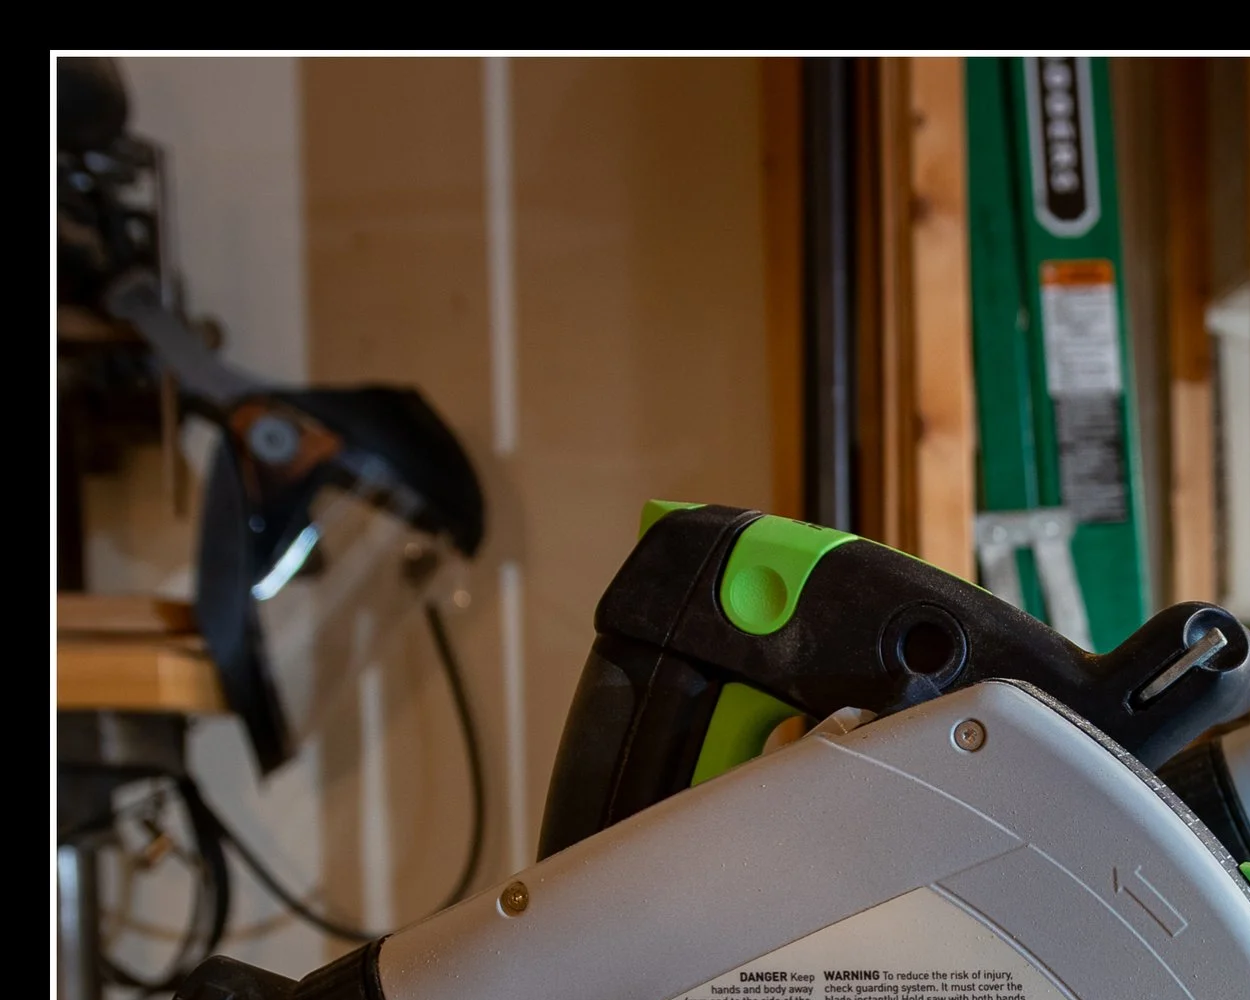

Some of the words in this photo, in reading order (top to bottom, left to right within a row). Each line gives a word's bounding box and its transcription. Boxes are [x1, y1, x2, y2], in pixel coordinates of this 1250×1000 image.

[740, 970, 788, 982] DANGER
[791, 971, 815, 984] Keep
[823, 970, 880, 981] WARNING
[883, 970, 894, 980] To
[897, 970, 930, 981] reduce
[932, 970, 948, 980] the
[951, 969, 969, 980] risk
[972, 969, 981, 979] of
[984, 969, 1013, 983] injury,
[711, 984, 741, 995] hands
[743, 984, 761, 994] and
[763, 983, 787, 997] body
[789, 985, 814, 997] away
[825, 983, 854, 993] check
[855, 982, 899, 996] guarding
[901, 982, 939, 996] system.
[941, 981, 949, 992] It
[951, 982, 976, 992] must
[978, 983, 1005, 992] cover
[1007, 980, 1022, 992] the
